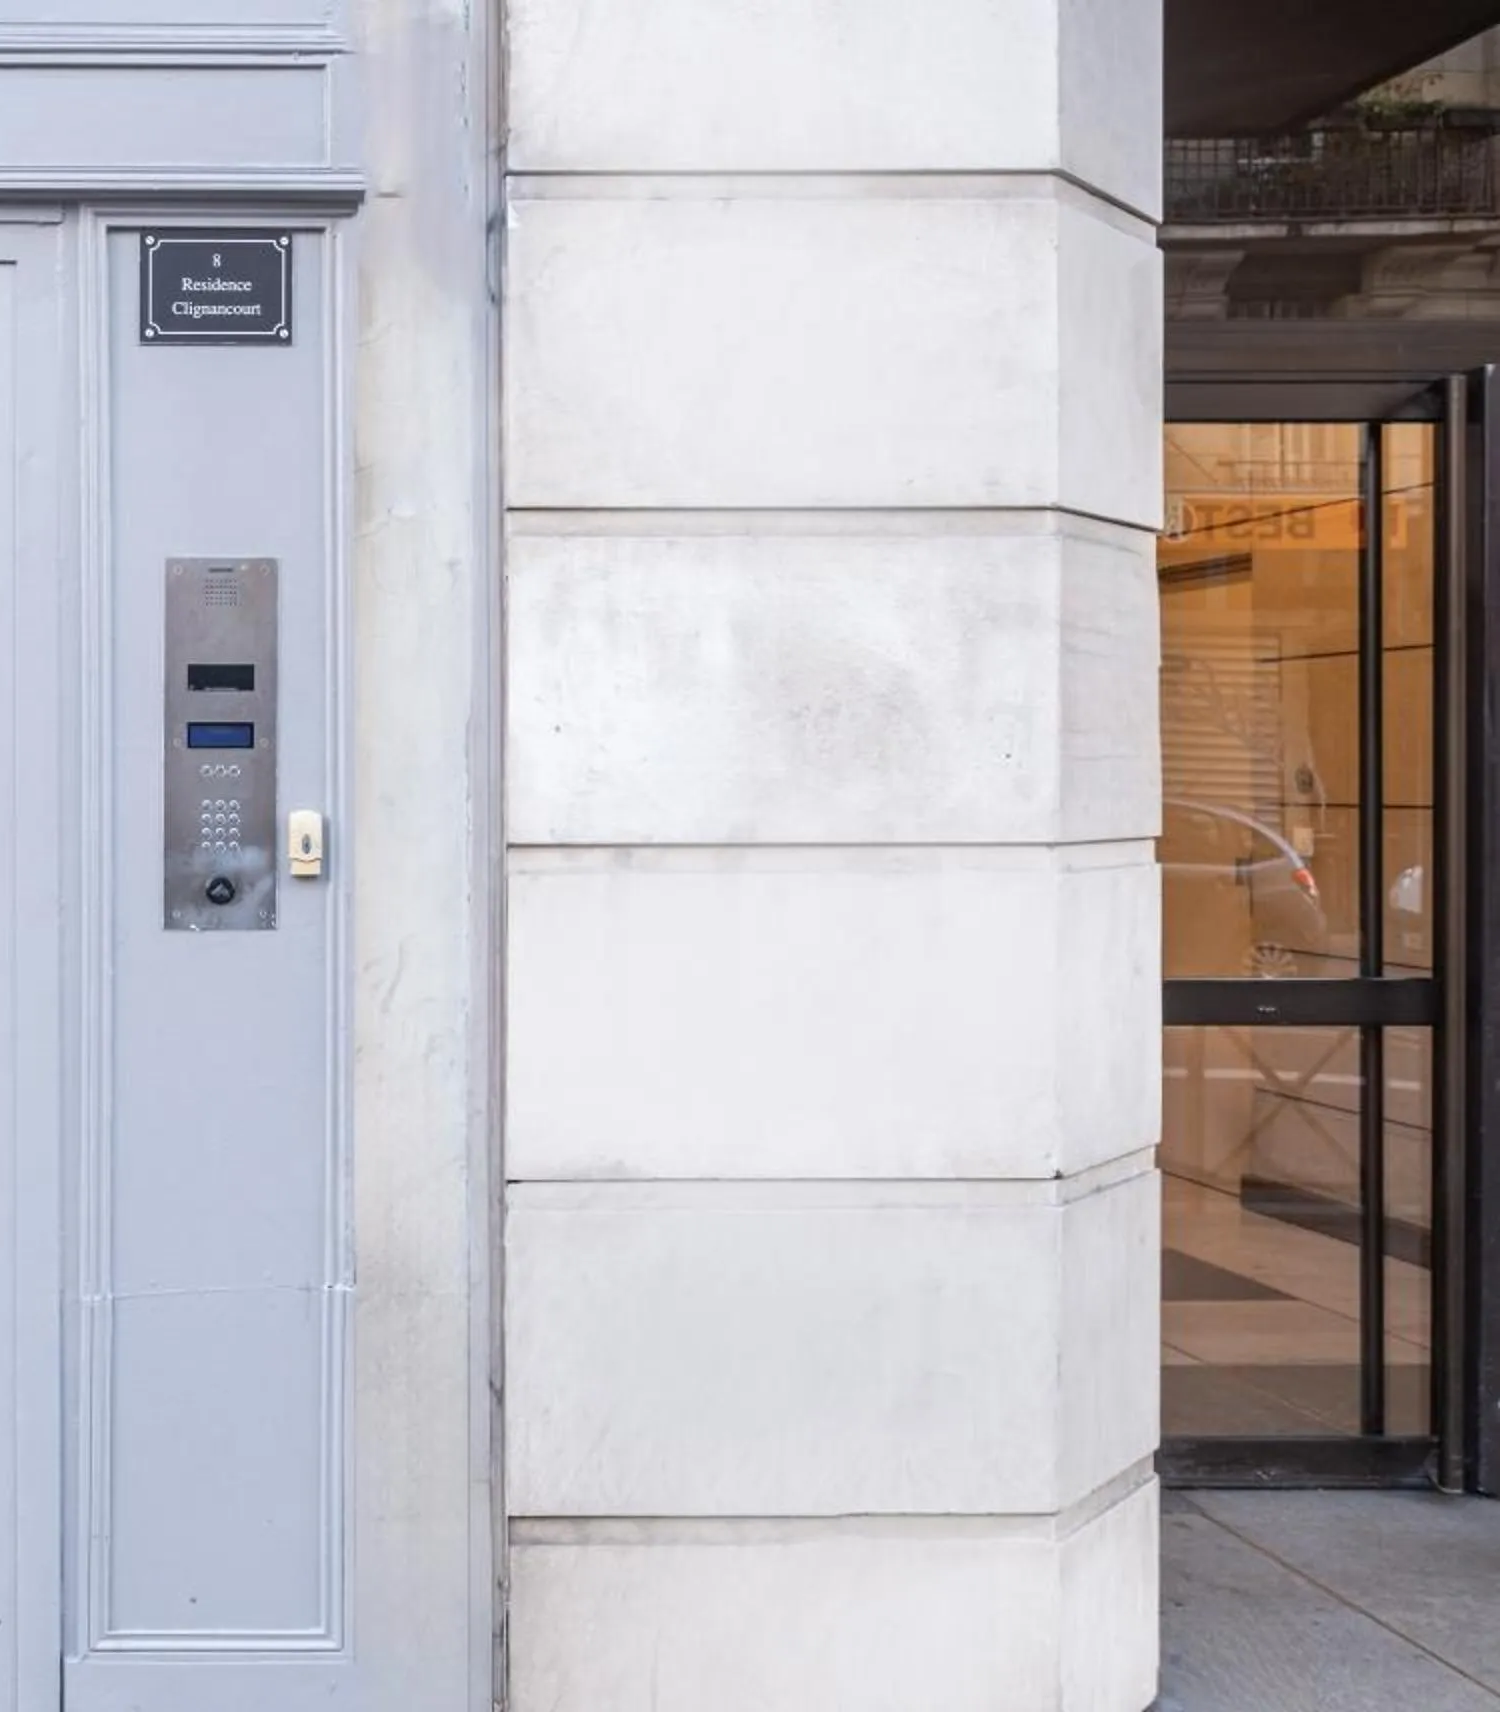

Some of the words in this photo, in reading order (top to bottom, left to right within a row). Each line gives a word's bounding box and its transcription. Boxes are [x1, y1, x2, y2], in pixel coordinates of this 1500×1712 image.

[212, 253, 222, 267] 8
[181, 277, 252, 291] Residence
[172, 301, 261, 318] Clignancourt
